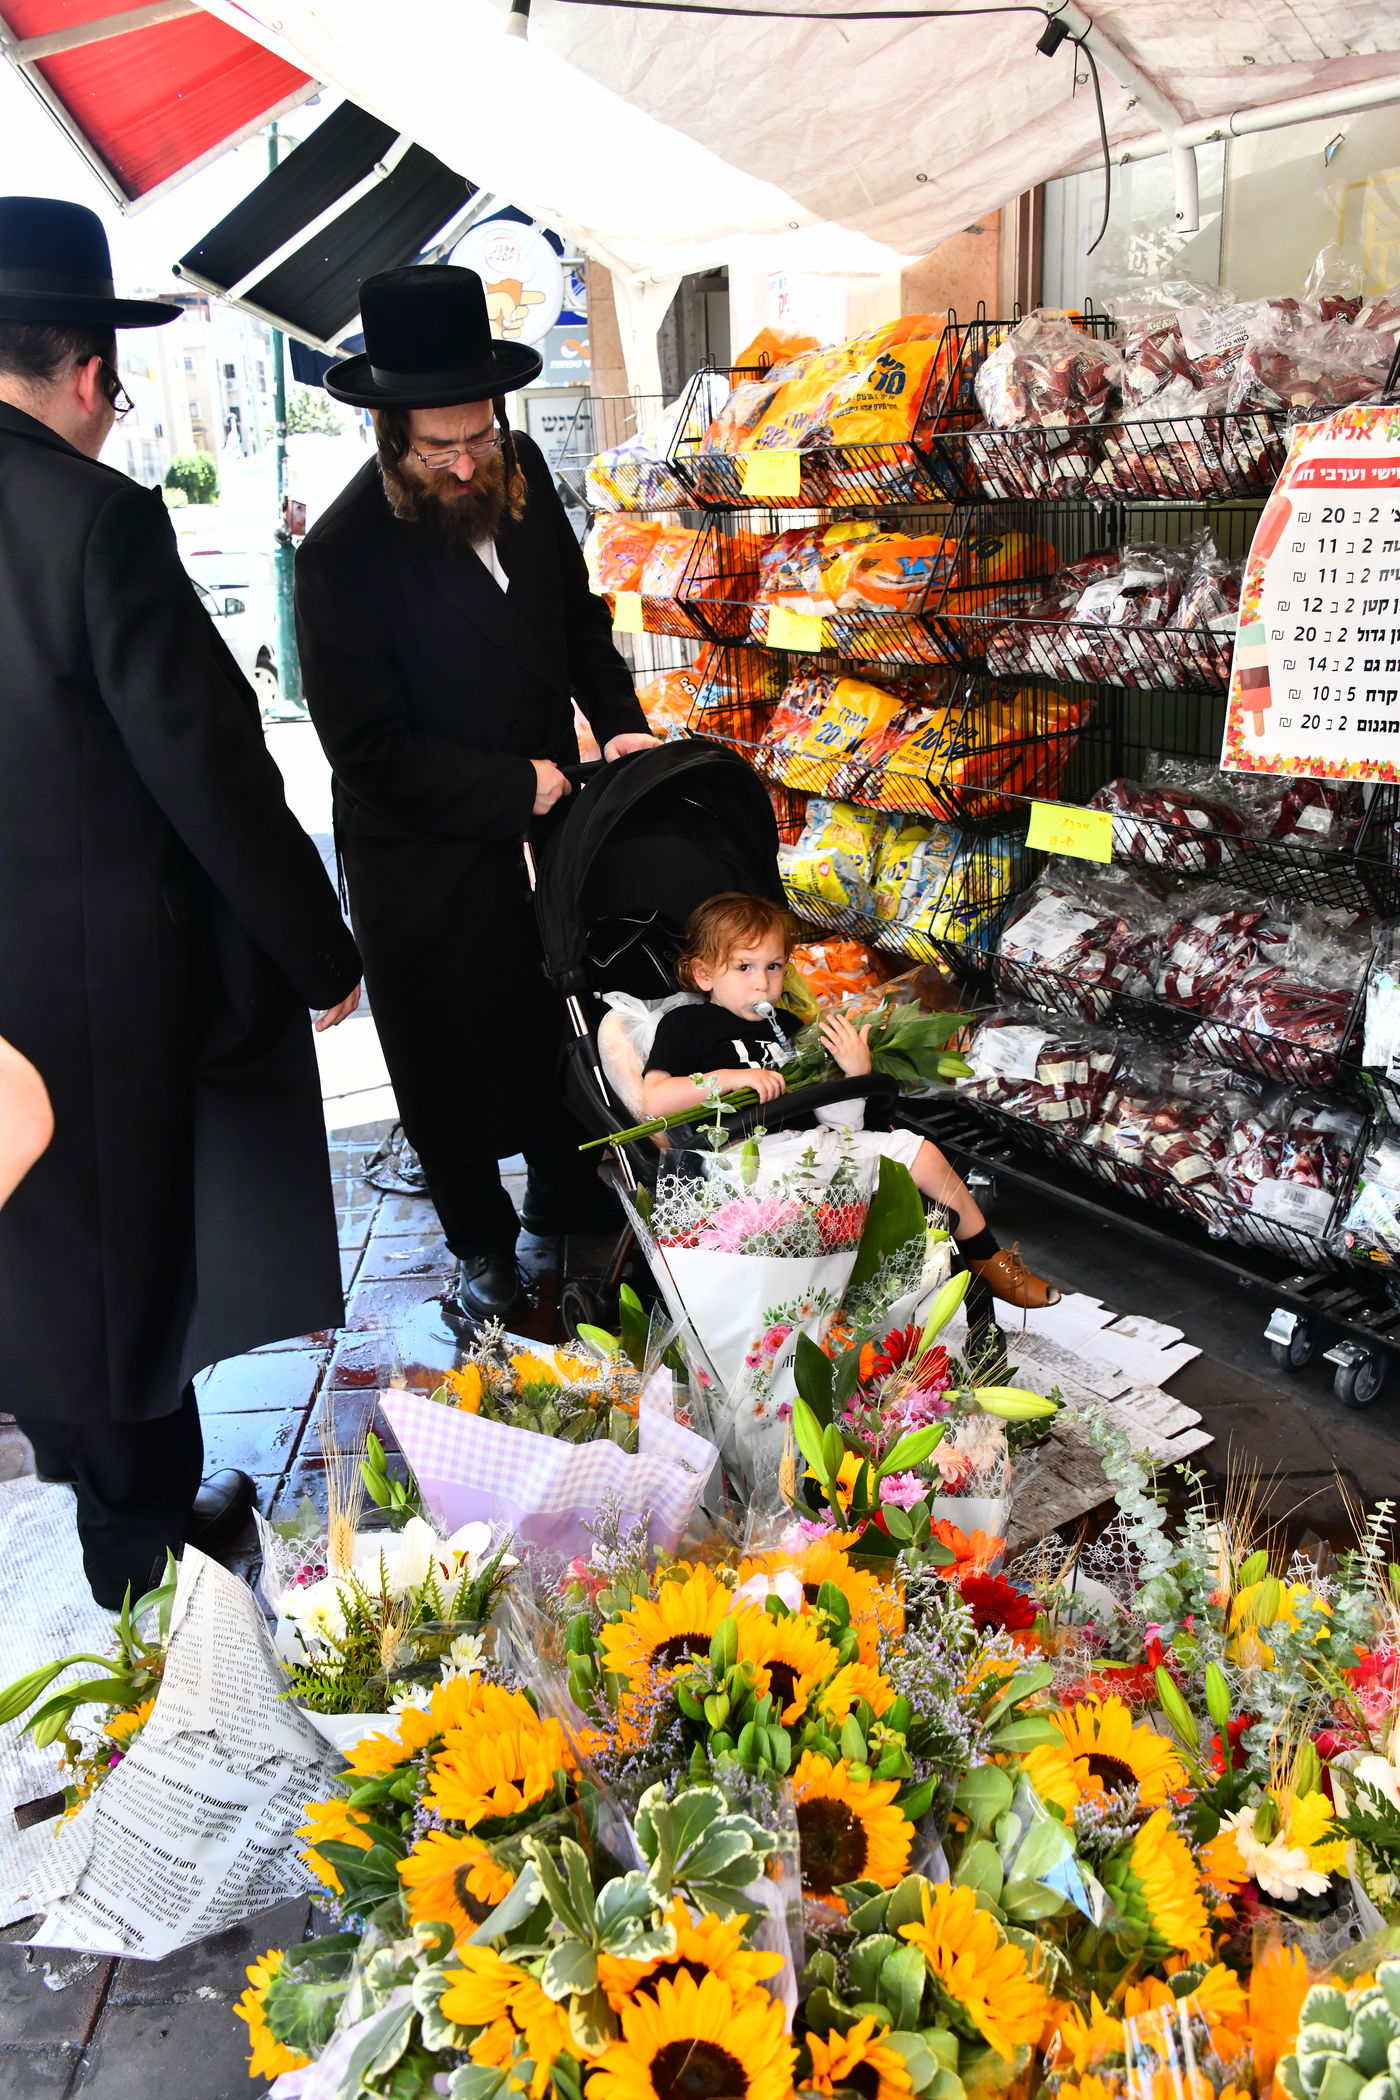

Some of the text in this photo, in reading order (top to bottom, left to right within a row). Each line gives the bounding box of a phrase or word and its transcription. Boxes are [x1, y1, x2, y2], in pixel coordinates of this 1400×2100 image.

[1295, 468, 1315, 481] חג
[1320, 468, 1366, 482] וערבי
[1321, 507, 1346, 524] 20
[1352, 511, 1360, 524] ב
[1368, 507, 1380, 523] 2
[1318, 538, 1338, 554] 11
[1345, 542, 1355, 554] ב
[1361, 538, 1373, 554] 2
[1318, 568, 1338, 584] 11
[1345, 572, 1355, 584] ב
[1360, 567, 1371, 584] 2
[1302, 597, 1324, 613] 12
[1330, 602, 1339, 614] ב
[1344, 597, 1355, 614] 2
[1362, 598, 1390, 616] קטן
[1293, 626, 1317, 642] 20
[1323, 631, 1332, 643] ב
[1337, 627, 1348, 643] 2
[1357, 626, 1386, 642] גדול
[1308, 656, 1327, 672] 14
[1331, 660, 1340, 672] ב
[1344, 656, 1355, 672] 2
[1363, 659, 1381, 672] גם
[1312, 685, 1330, 701] 10
[1334, 689, 1342, 702] ב
[1346, 686, 1356, 702] 5
[1366, 689, 1399, 706] קרח
[1300, 714, 1321, 730] 20
[1325, 718, 1333, 731] ב
[1338, 715, 1348, 731] 2
[1357, 719, 1400, 734] מגנום
[212, 1671, 252, 1687] wie ich für
[211, 1687, 251, 1705] obendrein
[242, 1686, 255, 1697] der
[210, 1696, 268, 1720] oben zitierten
[208, 1705, 230, 1718] quasi
[231, 1711, 240, 1719] in
[240, 1716, 257, 1728] sich
[257, 1722, 272, 1732] ein.
[215, 1717, 253, 1736] Chapeau!
[229, 1732, 258, 1750] Wiener
[259, 1741, 276, 1754] SPÖ
[276, 1747, 294, 1758] aber
[287, 1774, 320, 1793] Frühjahr
[160, 1773, 249, 1813] Austria expandieren
[167, 1791, 194, 1810] Austria
[197, 1807, 242, 1824] expandieren
[260, 1807, 277, 1823] Das
[267, 1798, 303, 1823] Vergleich
[166, 1815, 199, 1837] Glasgow
[120, 1824, 152, 1850] sparen
[152, 1845, 174, 1862] 4160
[172, 1856, 198, 1871] Euro
[245, 1837, 277, 1855] Toyota
[237, 1850, 254, 1863] Der
[140, 1850, 168, 1872] Bauern
[169, 1868, 189, 1882] sind
[154, 1870, 189, 1895] Umfrage
[189, 1888, 201, 1897] im
[140, 1892, 155, 1905] Die
[126, 1891, 164, 1922] Landwirte
[165, 1920, 178, 1930] ist
[169, 1901, 191, 1914] 4160
[91, 1898, 146, 1943] Stiefelkönig
